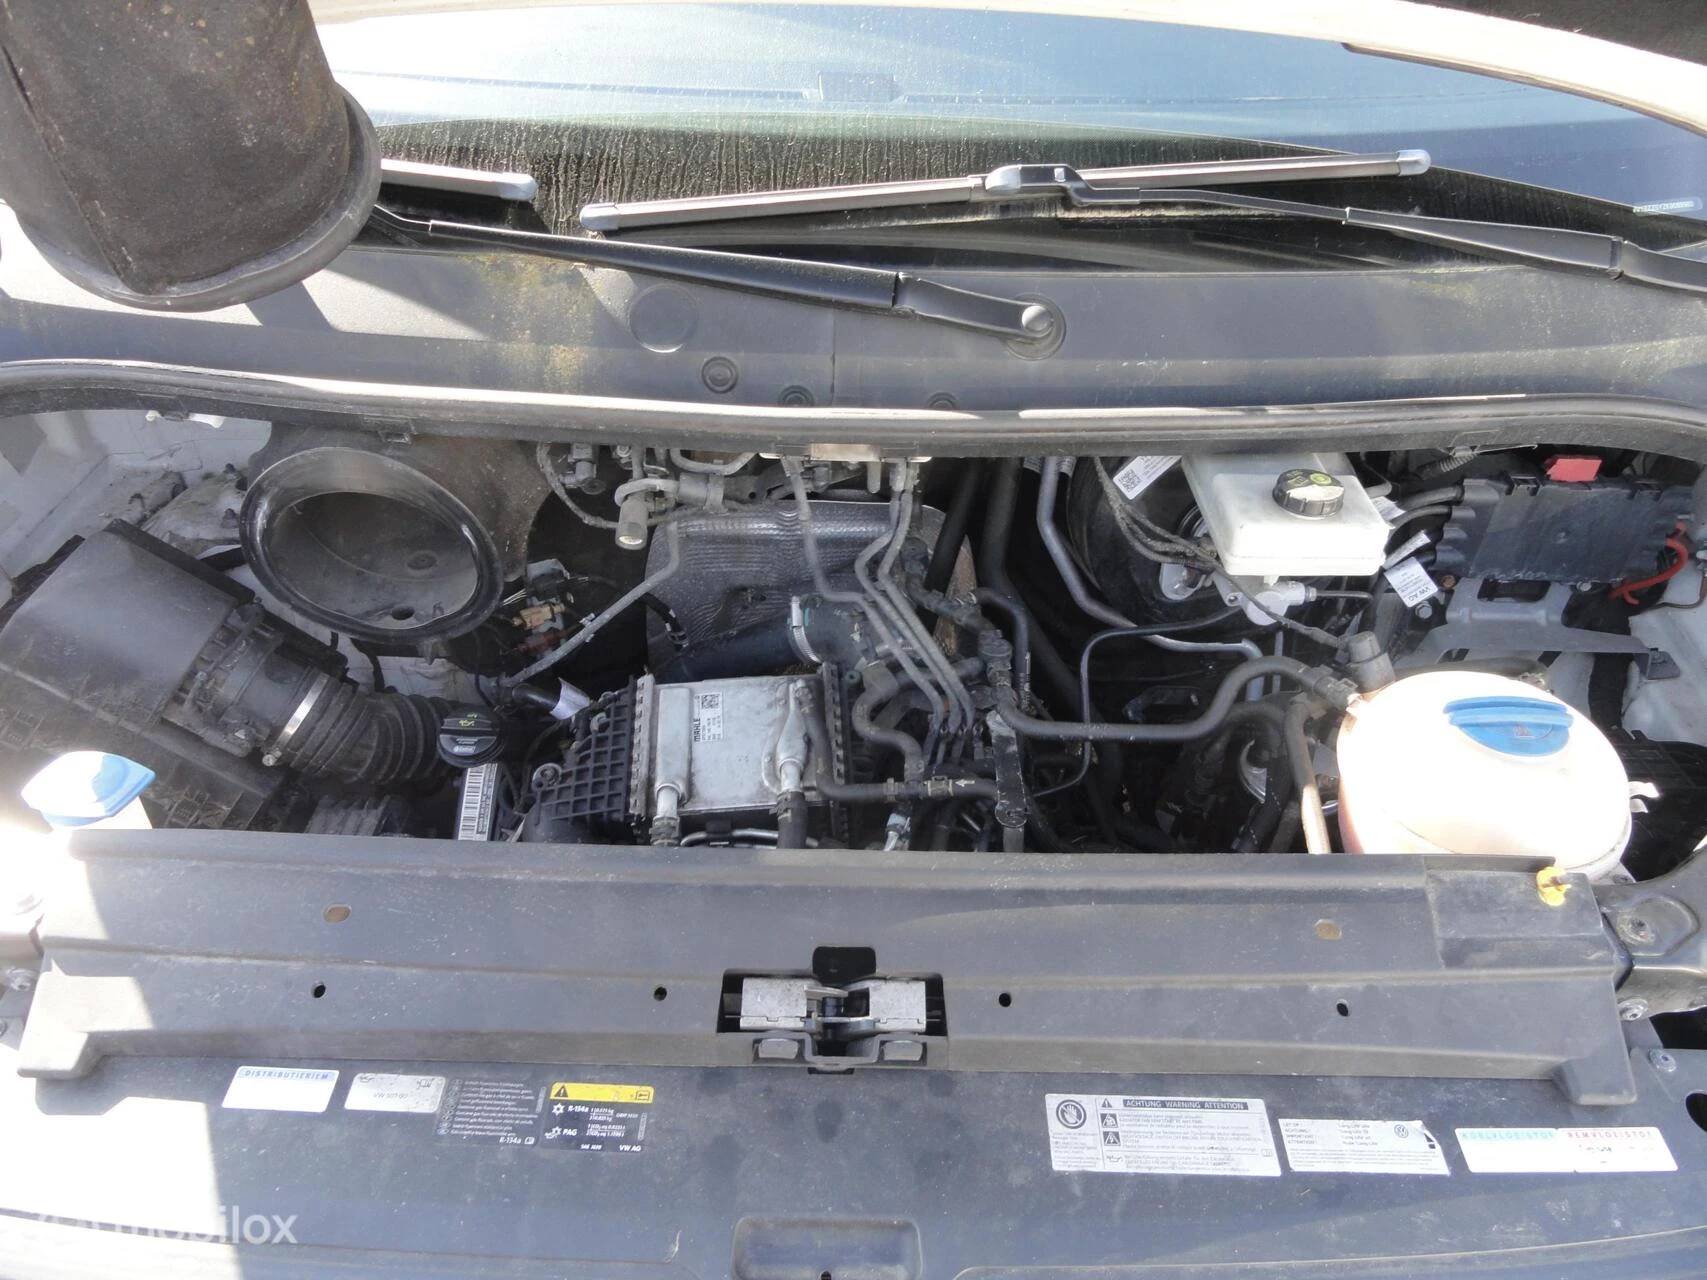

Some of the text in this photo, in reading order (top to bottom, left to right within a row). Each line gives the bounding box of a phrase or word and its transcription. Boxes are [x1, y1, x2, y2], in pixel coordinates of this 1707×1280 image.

[693, 717, 701, 742] MAHLE
[1126, 1100, 1244, 1110] ACHTUNG WARNING ATTENTION
[562, 1128, 578, 1136] PAG
